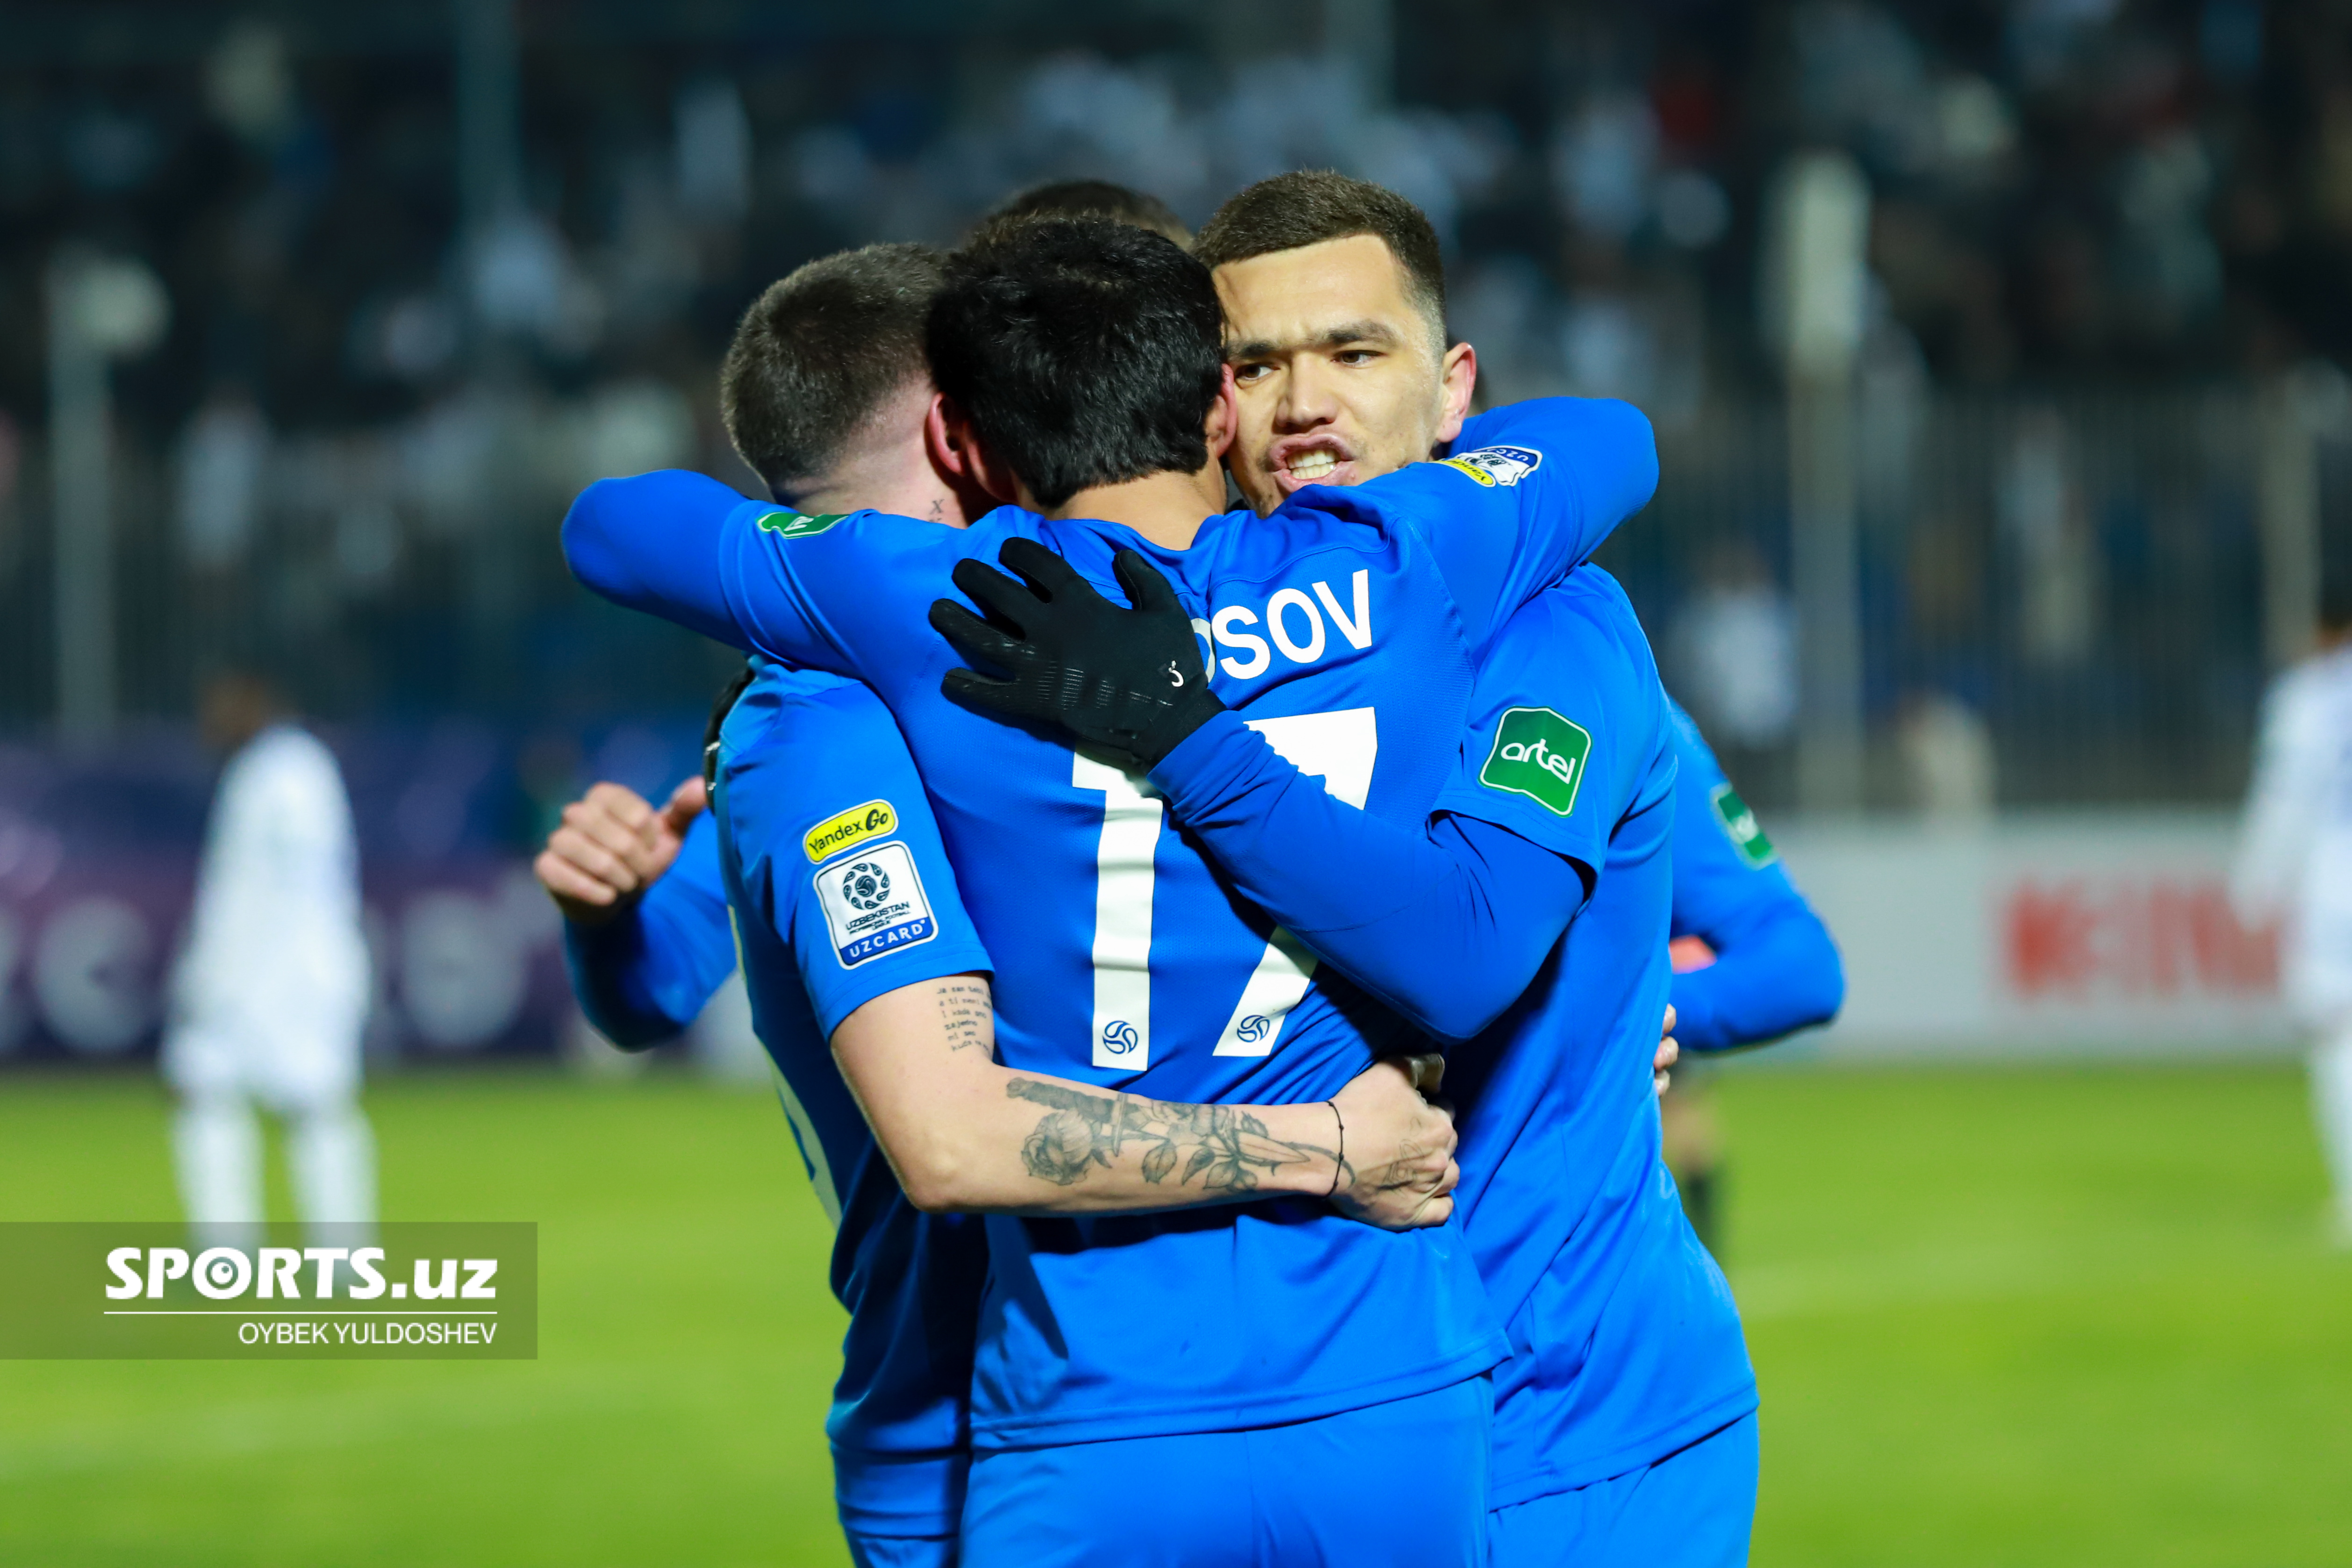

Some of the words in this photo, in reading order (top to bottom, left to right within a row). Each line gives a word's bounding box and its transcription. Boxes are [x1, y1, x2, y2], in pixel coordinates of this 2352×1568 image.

[1500, 738, 1577, 785] artel
[809, 820, 864, 854] Yandex
[866, 809, 888, 831] Go
[846, 901, 910, 931] UZBEKISTAN
[849, 923, 924, 958] UZCARD
